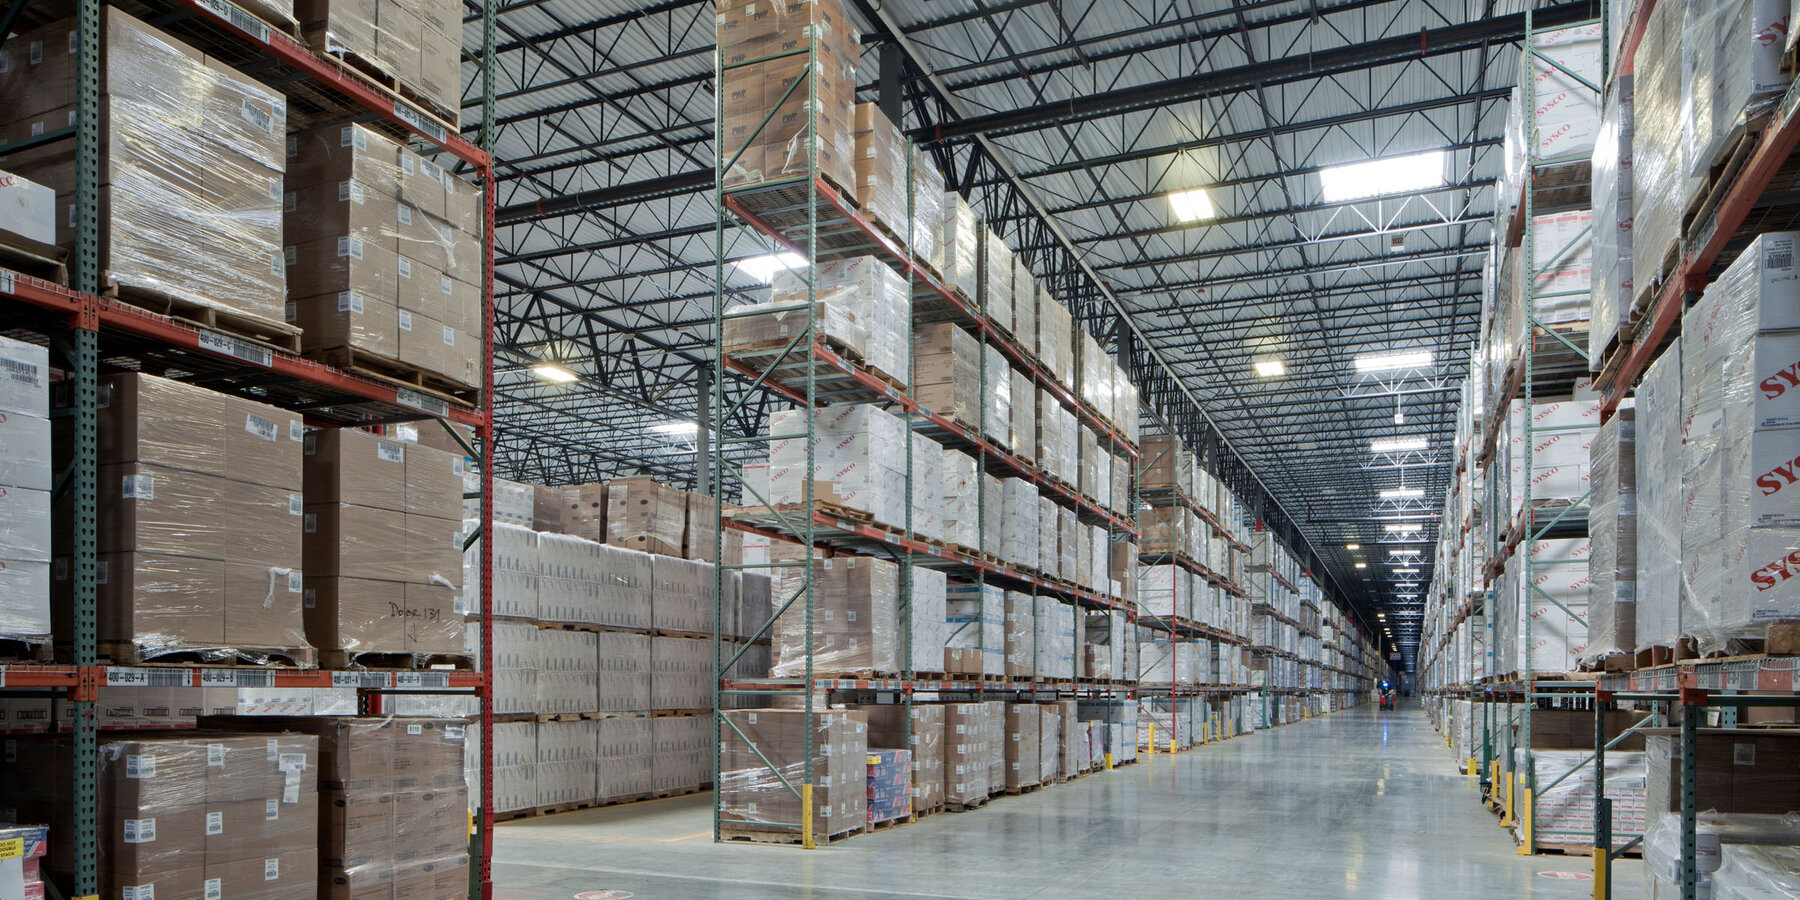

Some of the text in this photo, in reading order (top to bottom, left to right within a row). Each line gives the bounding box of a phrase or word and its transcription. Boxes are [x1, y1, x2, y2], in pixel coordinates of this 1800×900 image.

[782, 40, 797, 50] PWP
[1536, 92, 1567, 116] SYSCO
[1541, 123, 1571, 148] SYSCO
[835, 406, 855, 422] SYSCO
[1533, 403, 1561, 422] SYSCO
[771, 440, 790, 455] SYSCO
[835, 435, 855, 450] SYSCO
[1533, 435, 1561, 454] SYSCO
[770, 467, 789, 483] SYSCO
[835, 462, 856, 479] SYSCO
[1532, 466, 1560, 485] SYSCO
[108, 672, 145, 683] 400-029-A
[202, 672, 234, 683] 400-029-B
